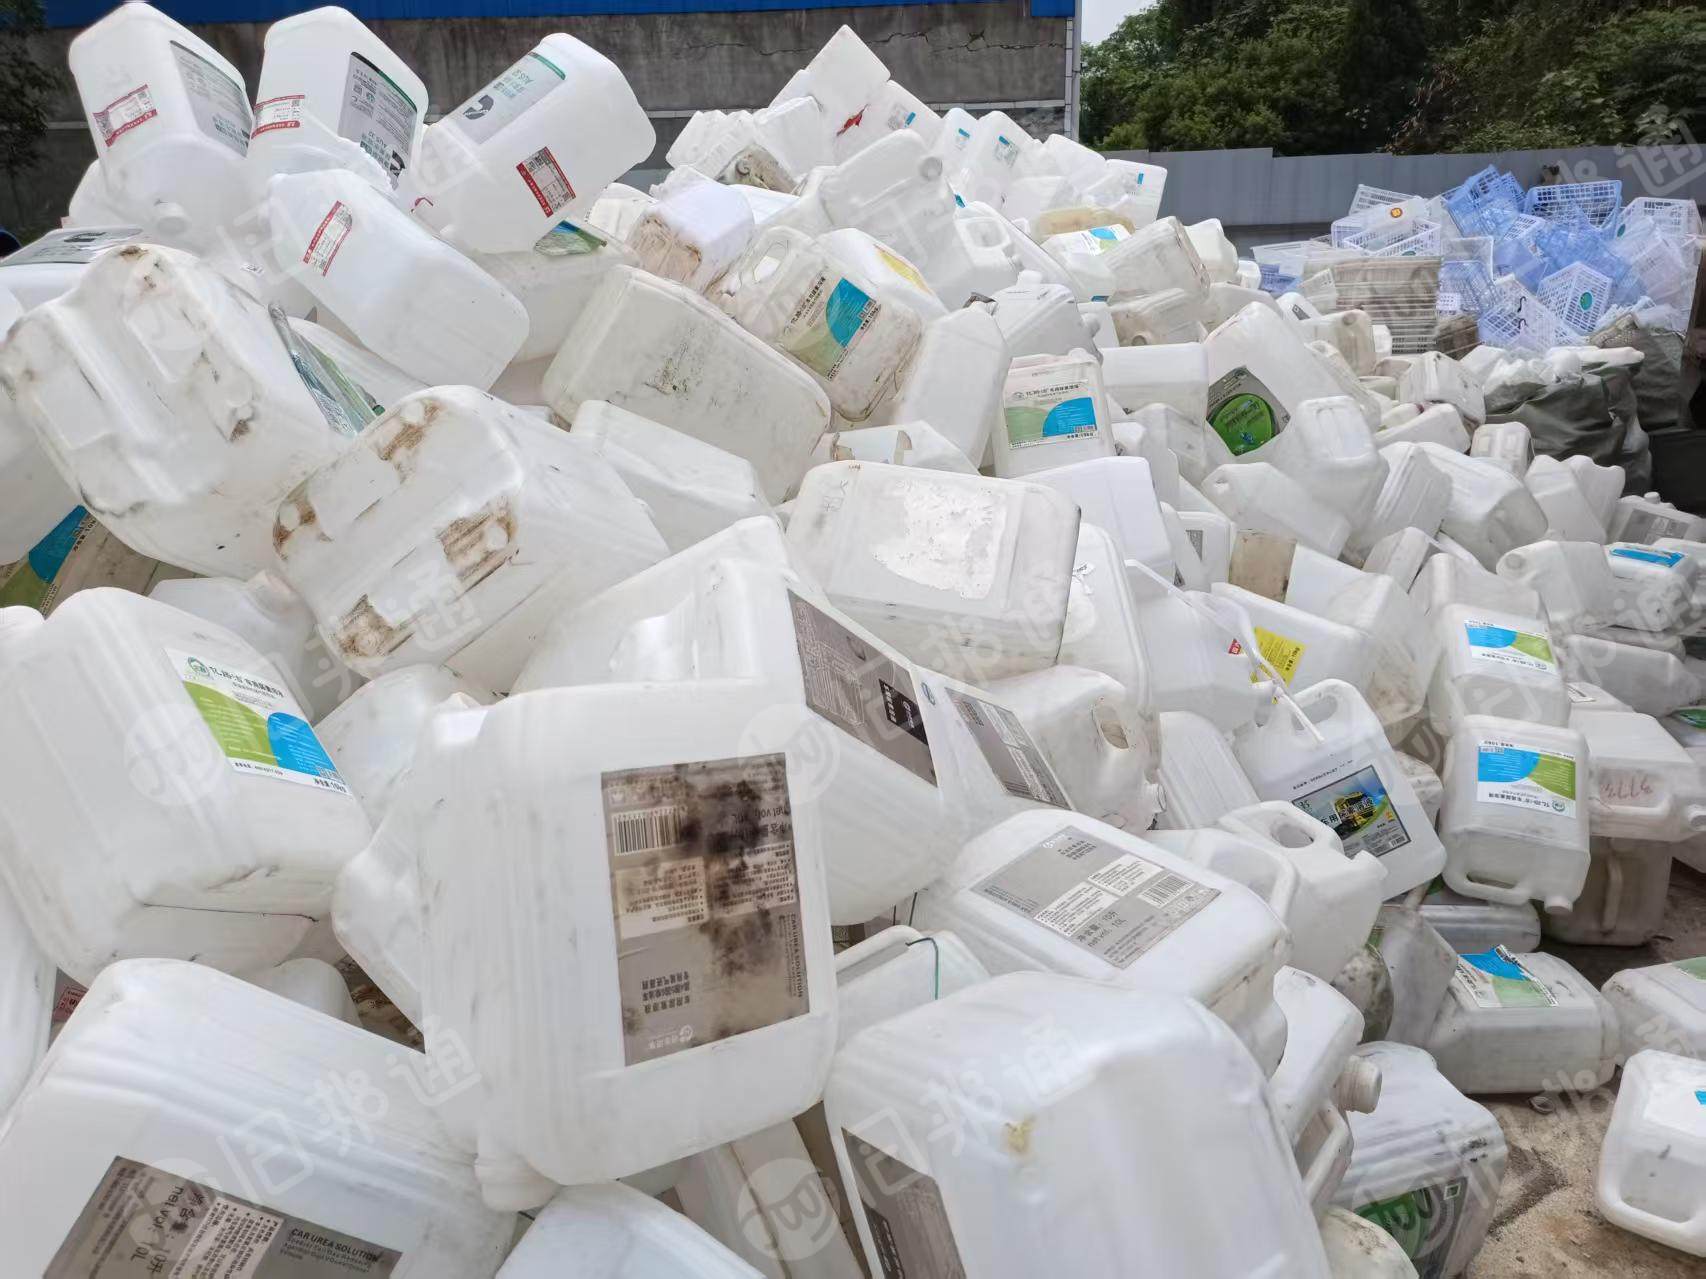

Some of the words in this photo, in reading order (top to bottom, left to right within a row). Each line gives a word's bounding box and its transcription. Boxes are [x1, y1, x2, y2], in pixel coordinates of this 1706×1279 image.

[290, 1228, 312, 1244] CAR
[311, 1234, 334, 1249] UREA
[334, 1241, 379, 1264] SOLUTION
